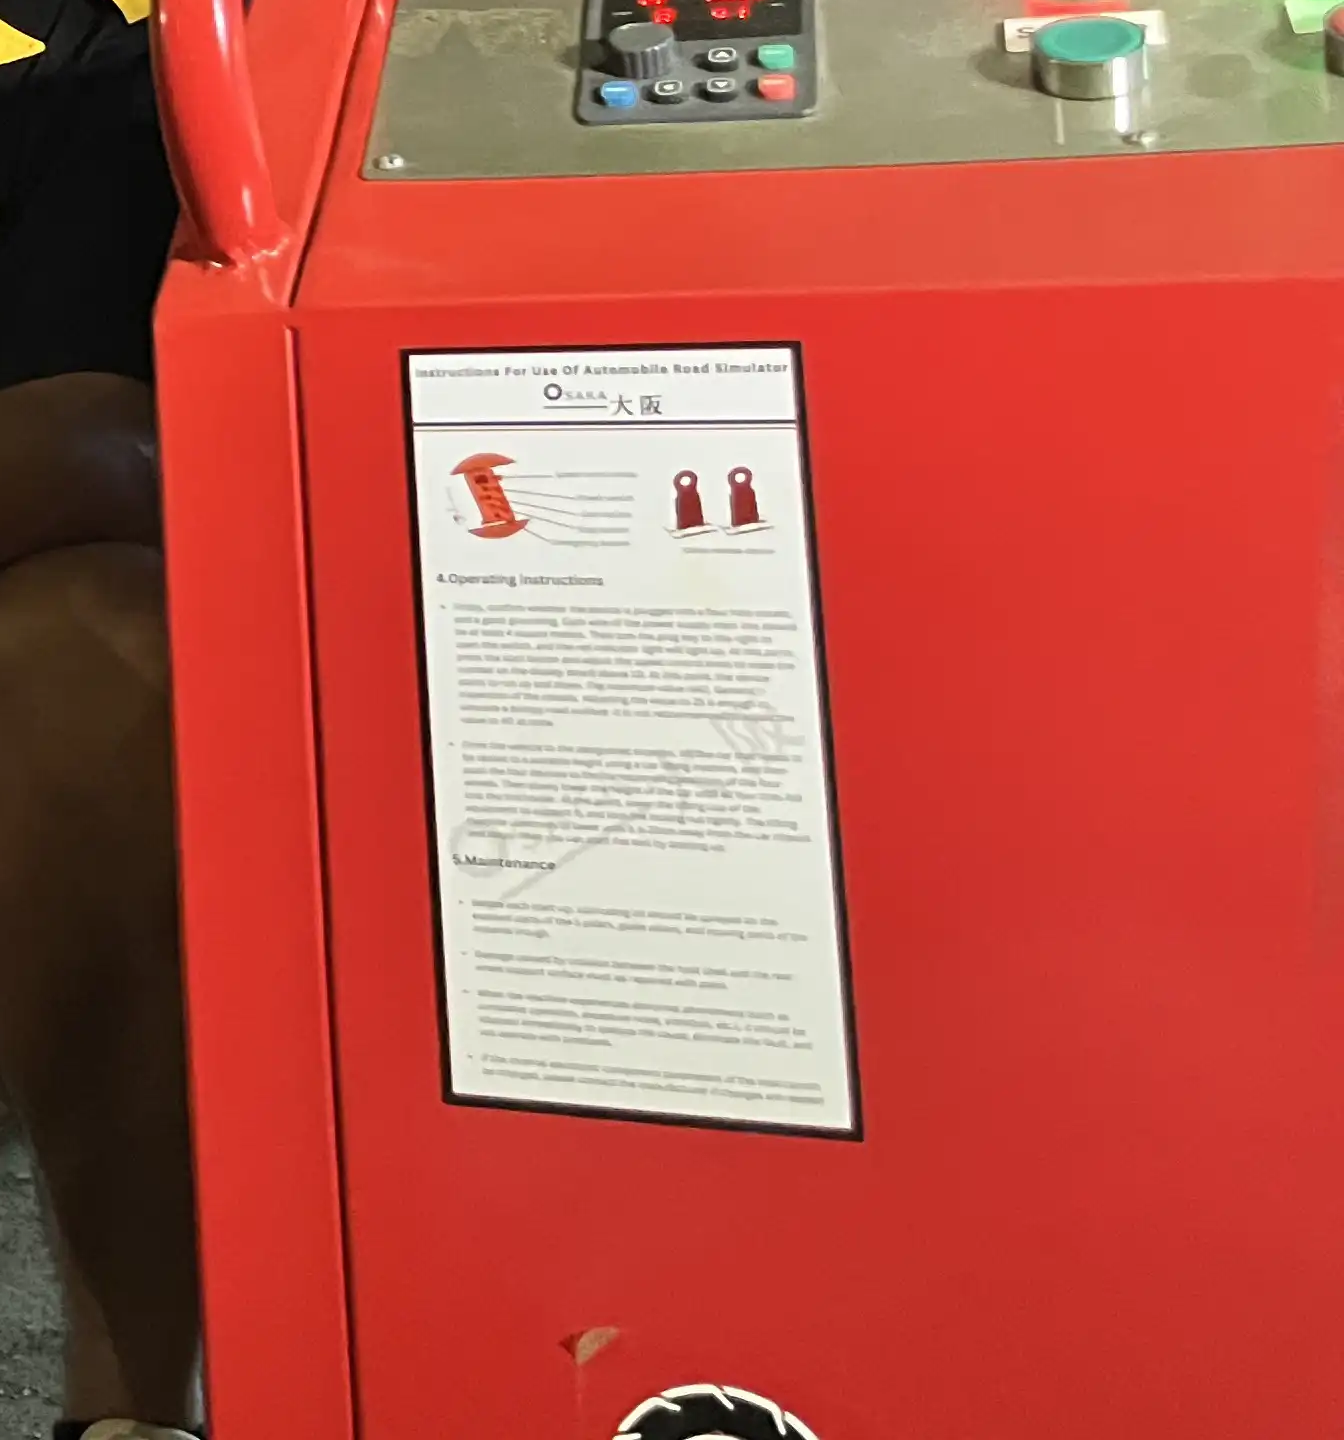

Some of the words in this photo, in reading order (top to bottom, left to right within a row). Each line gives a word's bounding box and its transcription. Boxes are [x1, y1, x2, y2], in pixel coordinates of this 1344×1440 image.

[415, 367, 500, 378] Instructions
[504, 366, 527, 377] For
[532, 366, 558, 376] Use
[562, 365, 579, 376] Of
[583, 363, 669, 376] Automobile
[673, 363, 710, 374] Road
[715, 362, 788, 374] Simulator
[610, 393, 663, 417] 大阪
[452, 853, 556, 870] 5.Mtenance
